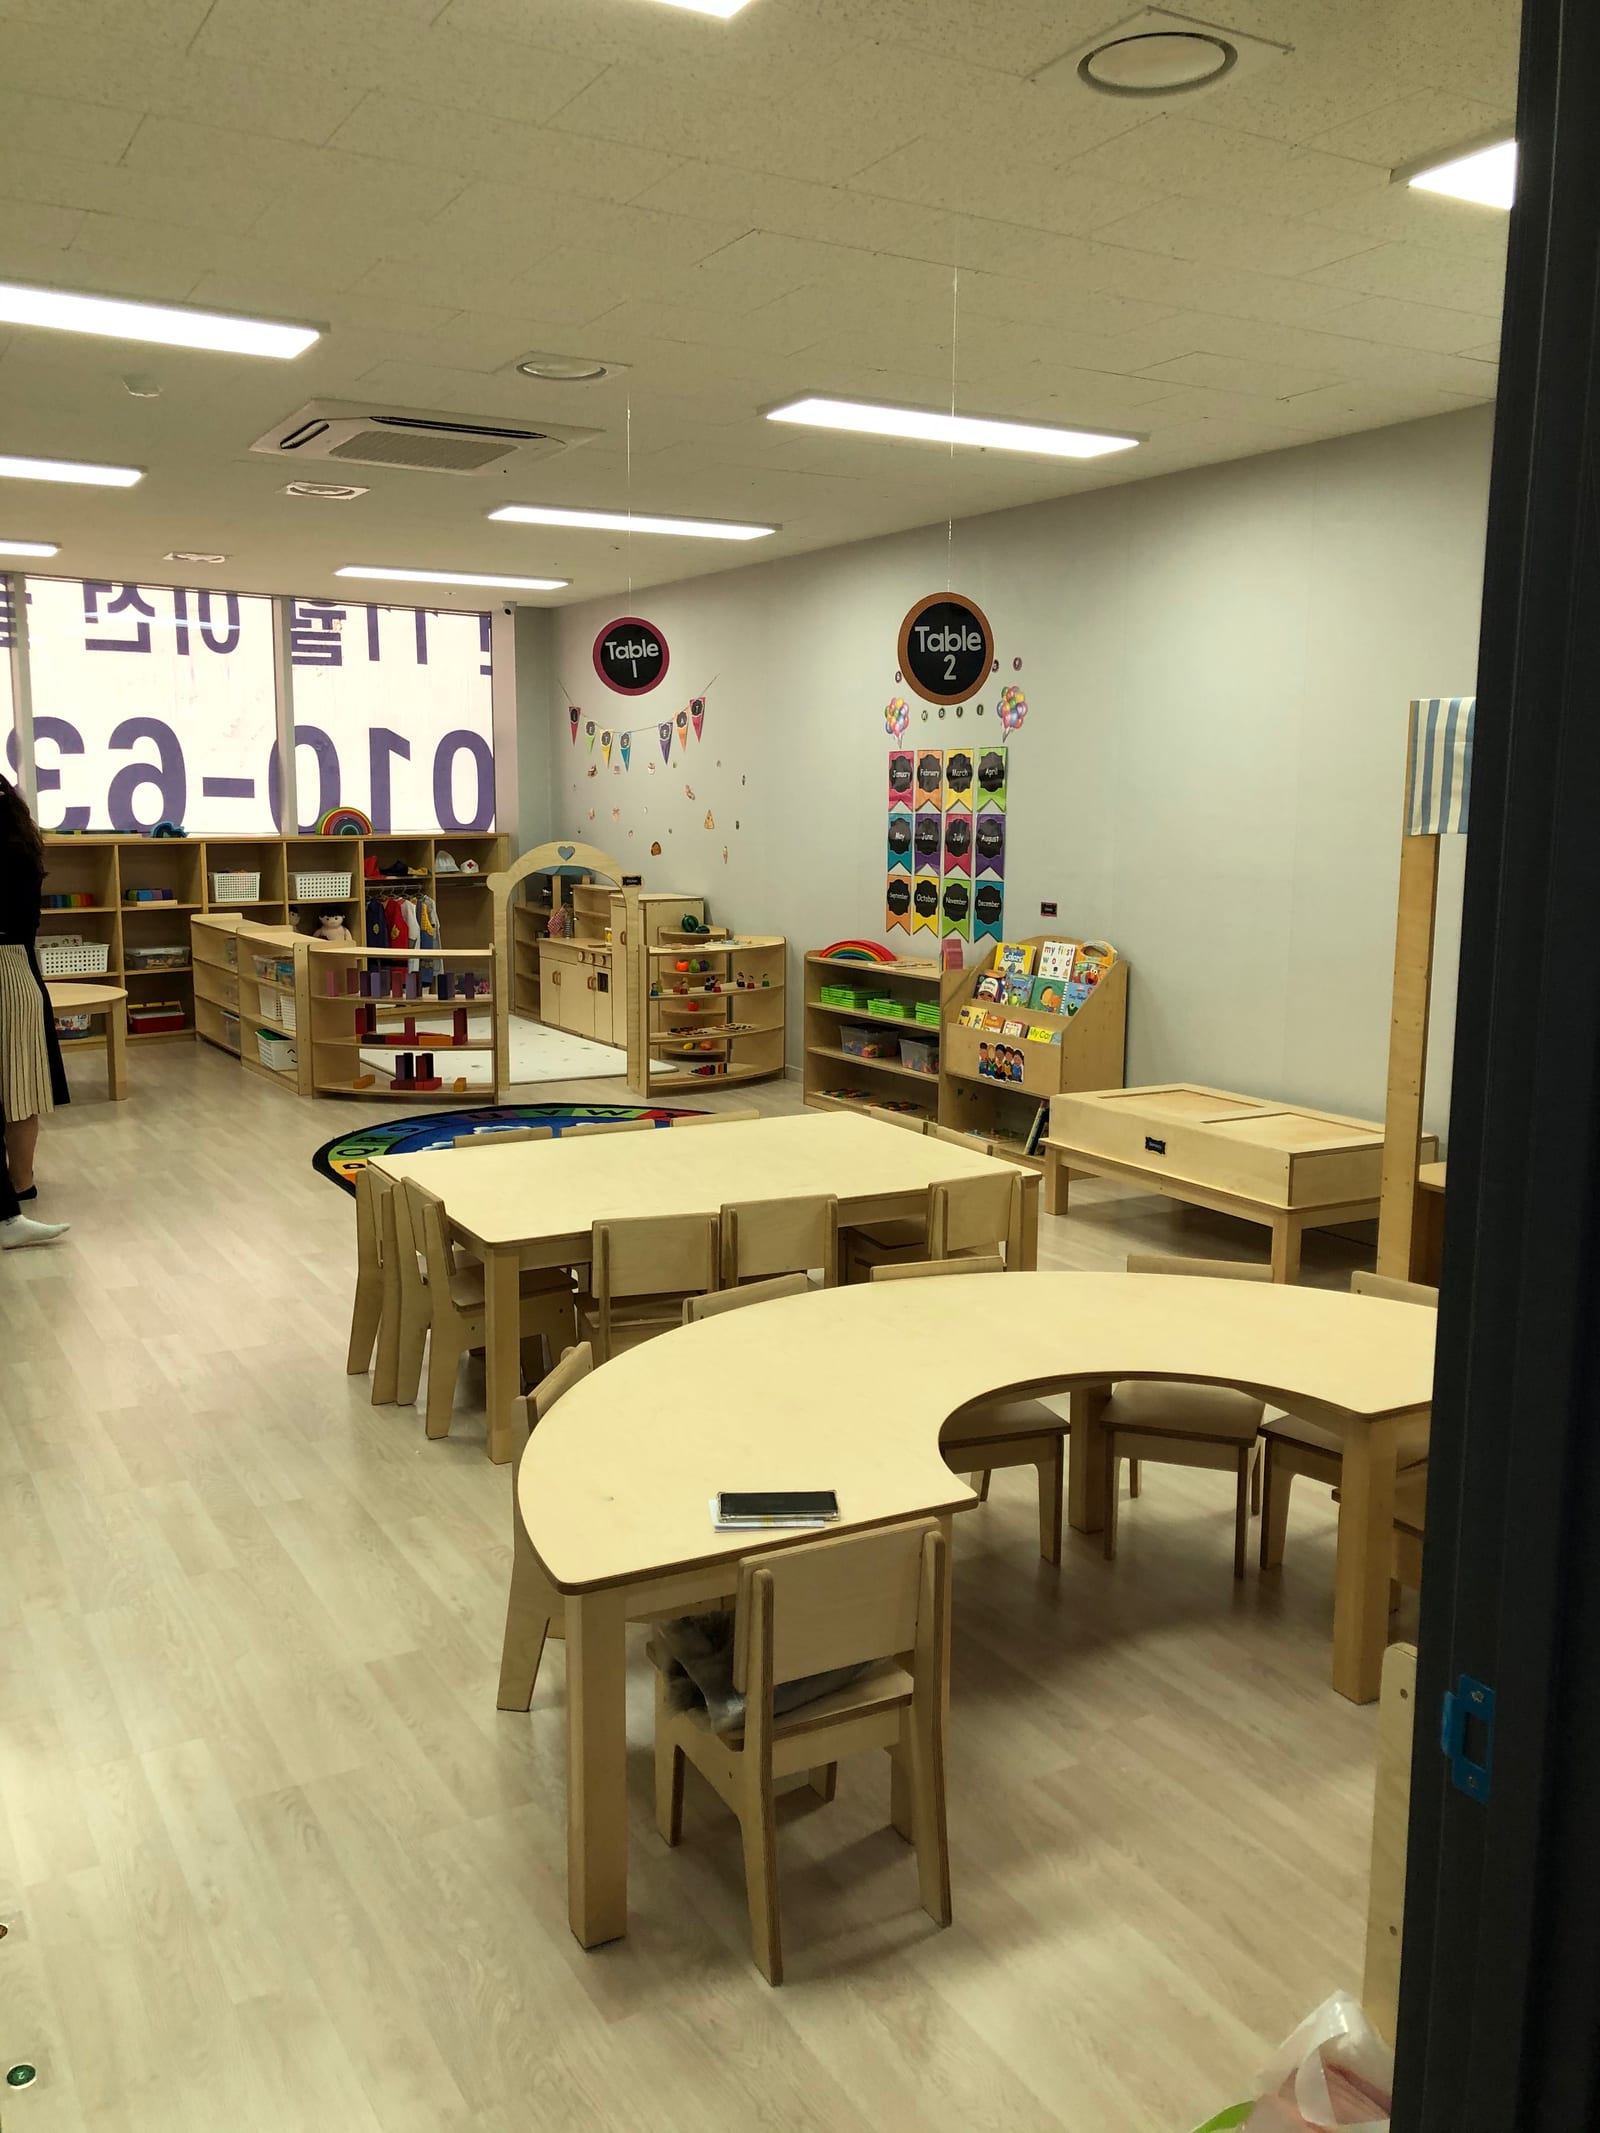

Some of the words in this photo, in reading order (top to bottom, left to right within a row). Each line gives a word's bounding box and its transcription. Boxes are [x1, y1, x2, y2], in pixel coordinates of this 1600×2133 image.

[914, 625, 982, 653] Table
[604, 639, 660, 660] Table
[943, 654, 957, 681] 2
[892, 770, 911, 779] January
[920, 769, 939, 779] February
[951, 769, 968, 777] March
[985, 768, 999, 778] April
[895, 832, 905, 842] May
[921, 832, 934, 841] June
[952, 833, 964, 843] July
[981, 834, 1000, 845] August
[916, 894, 937, 903] October
[945, 896, 967, 905] November
[978, 899, 1000, 908] December
